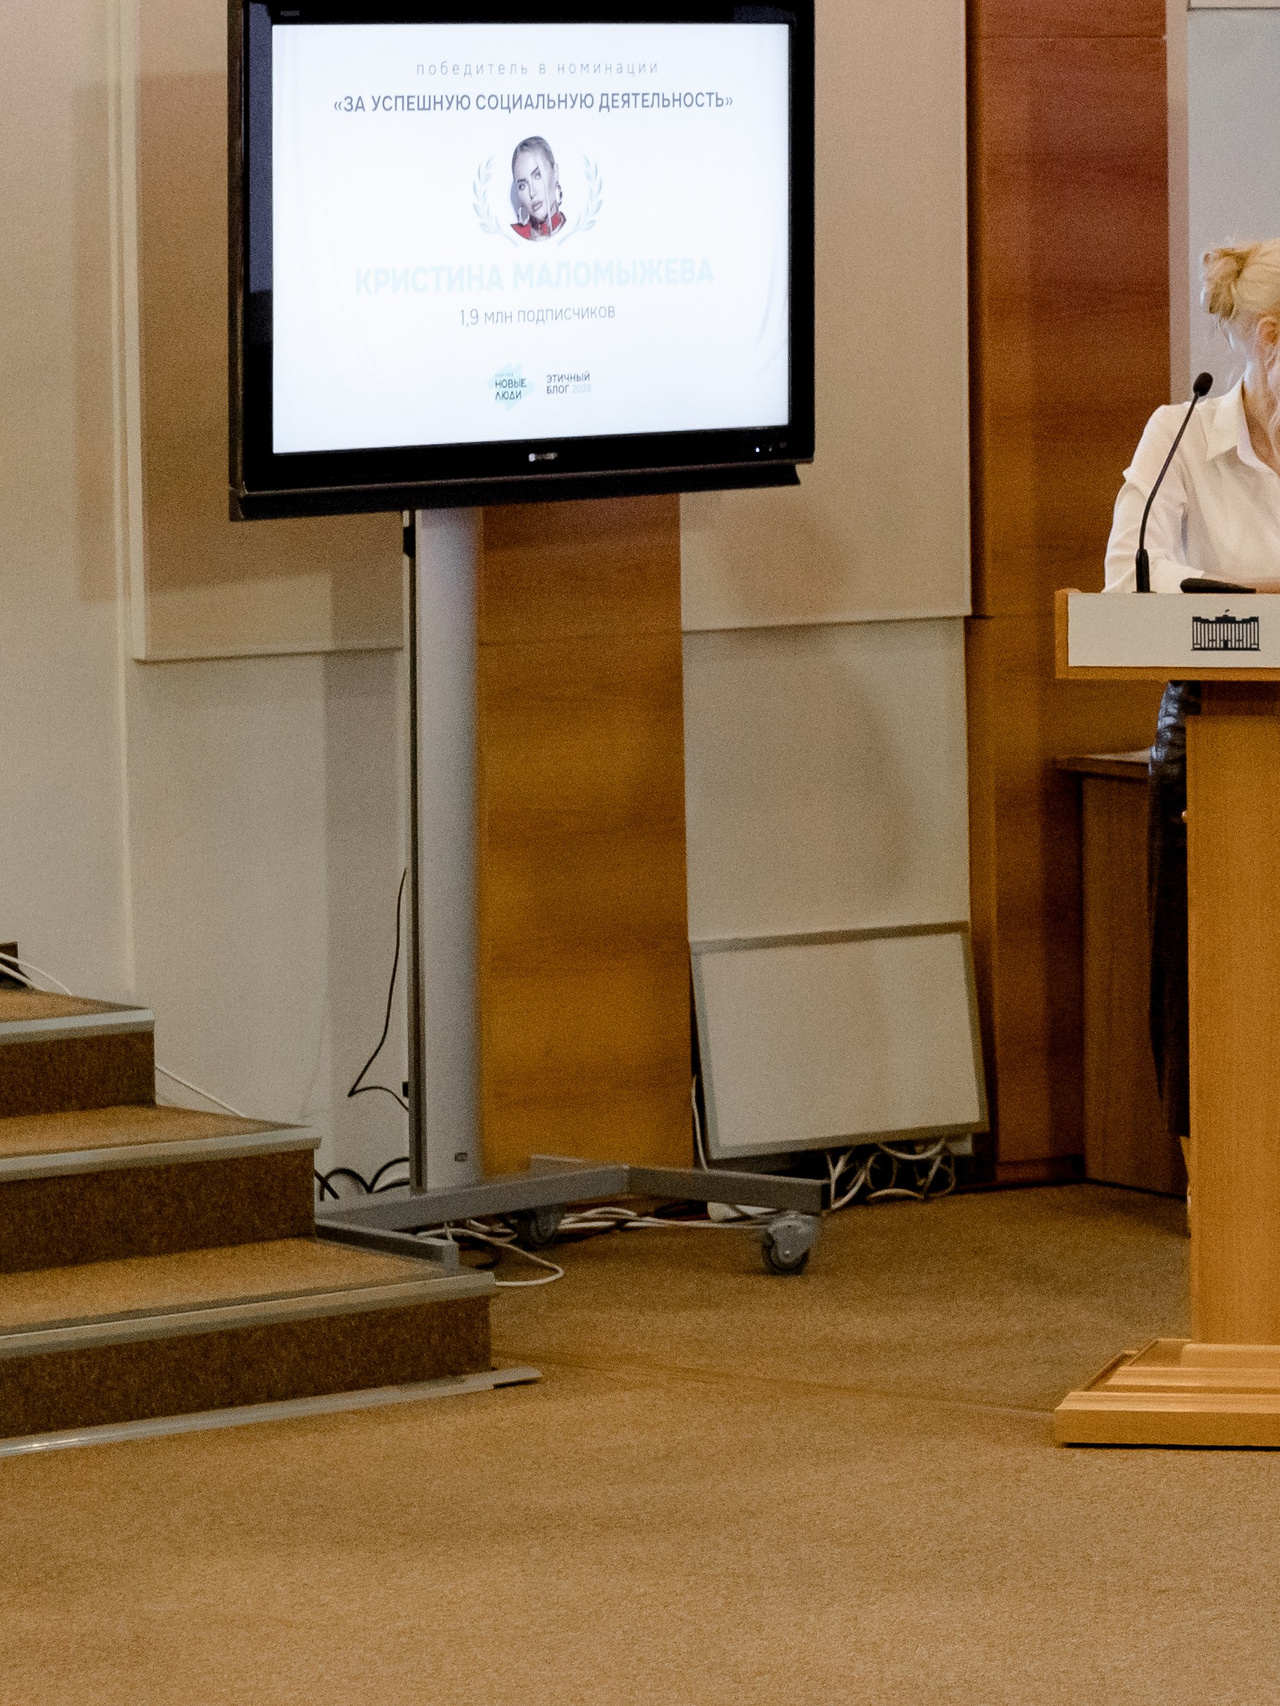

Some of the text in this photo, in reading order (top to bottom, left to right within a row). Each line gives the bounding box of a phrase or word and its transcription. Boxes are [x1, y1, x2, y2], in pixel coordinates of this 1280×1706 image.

[416, 61, 658, 78] победитель в номинации
[333, 91, 733, 114] «ЗА УСПЕШНУЮ СОЦИАЛЬНУЮ ДЕЯТЕЛЬНОСТЬ»
[355, 256, 714, 296] КРИСТИНА МАЛОМЫЖЕВА
[459, 308, 479, 328] 1,9
[494, 378, 527, 389] НОВЫЕ
[546, 370, 591, 384] ЭТИЧНЫЙ
[494, 390, 522, 401] ЛЮДИ
[546, 384, 570, 395] БЛОГ
